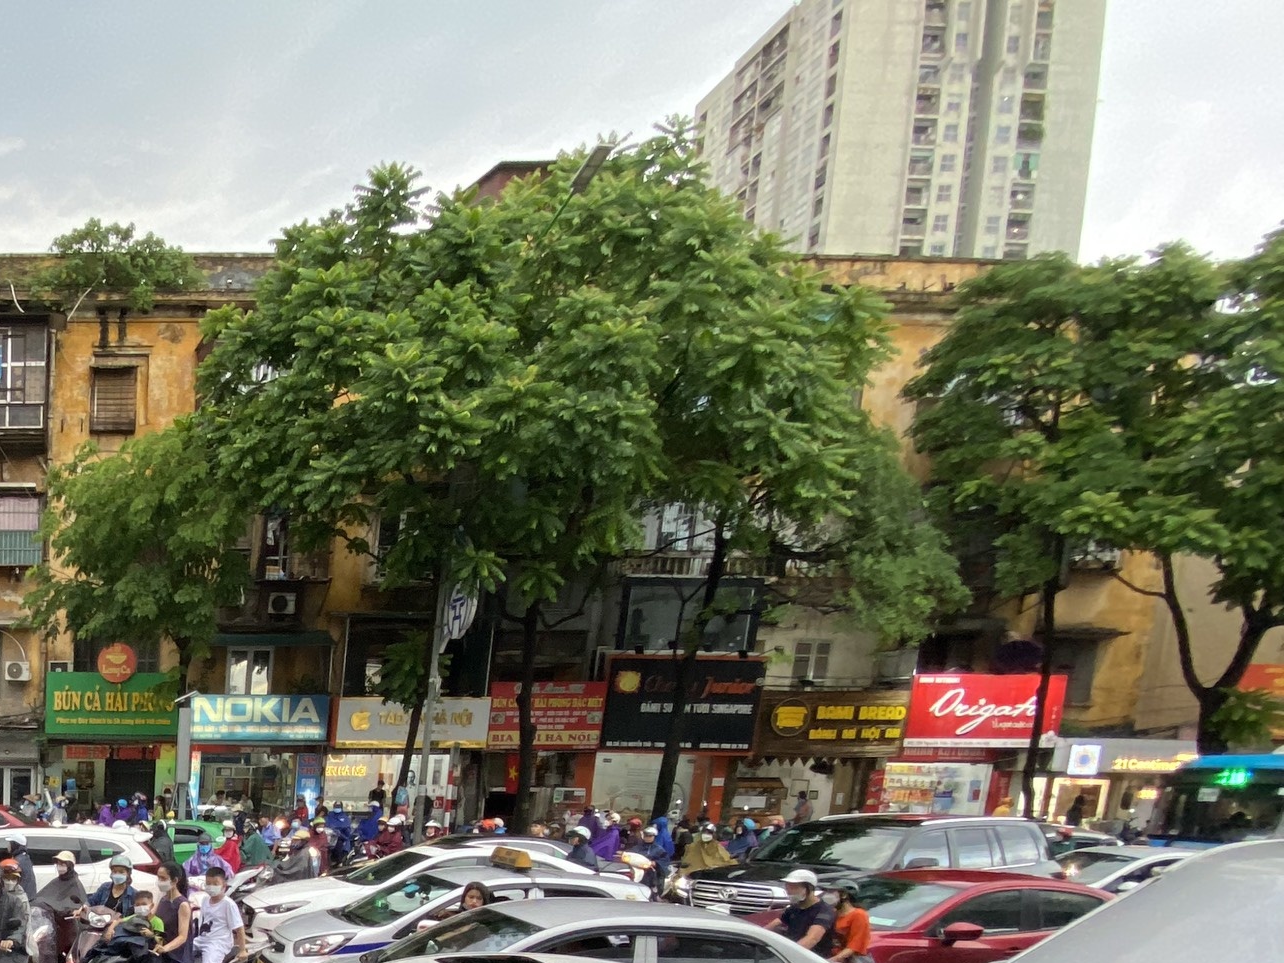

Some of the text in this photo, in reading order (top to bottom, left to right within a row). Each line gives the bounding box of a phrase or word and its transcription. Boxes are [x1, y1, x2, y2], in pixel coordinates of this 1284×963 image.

[54, 685, 81, 711] BÚN
[84, 685, 102, 711] CÁ
[194, 697, 320, 723] NOKIA
[929, 688, 1037, 735] Origat
[492, 734, 514, 742] BIA
